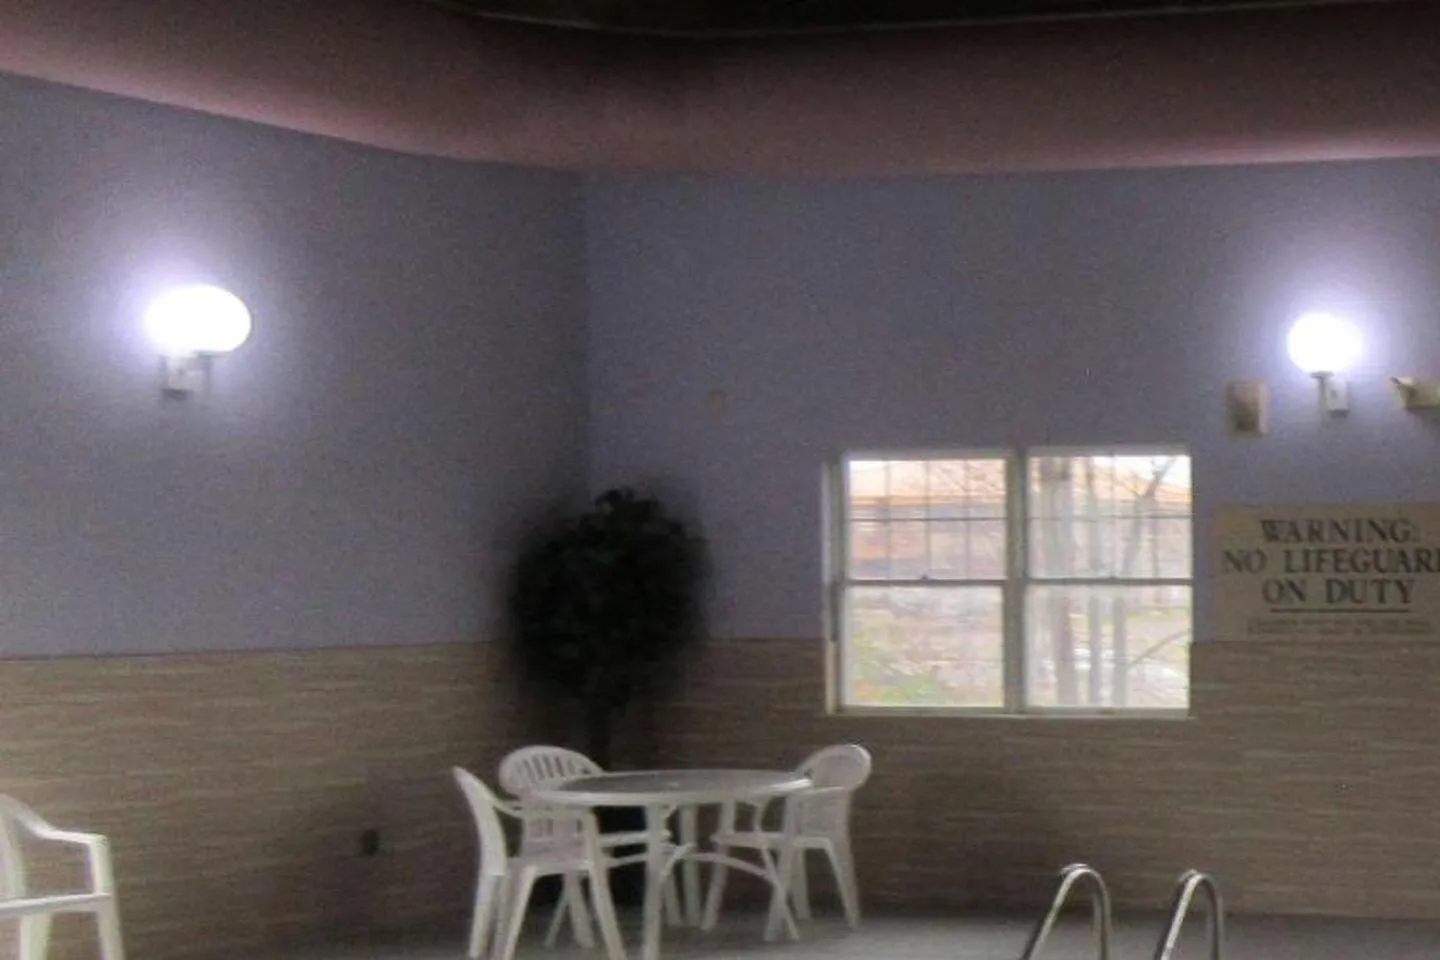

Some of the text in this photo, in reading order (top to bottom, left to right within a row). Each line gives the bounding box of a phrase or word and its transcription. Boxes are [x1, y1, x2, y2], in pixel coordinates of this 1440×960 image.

[1221, 548, 1268, 574] NO
[1261, 578, 1416, 604] ON DUTY
